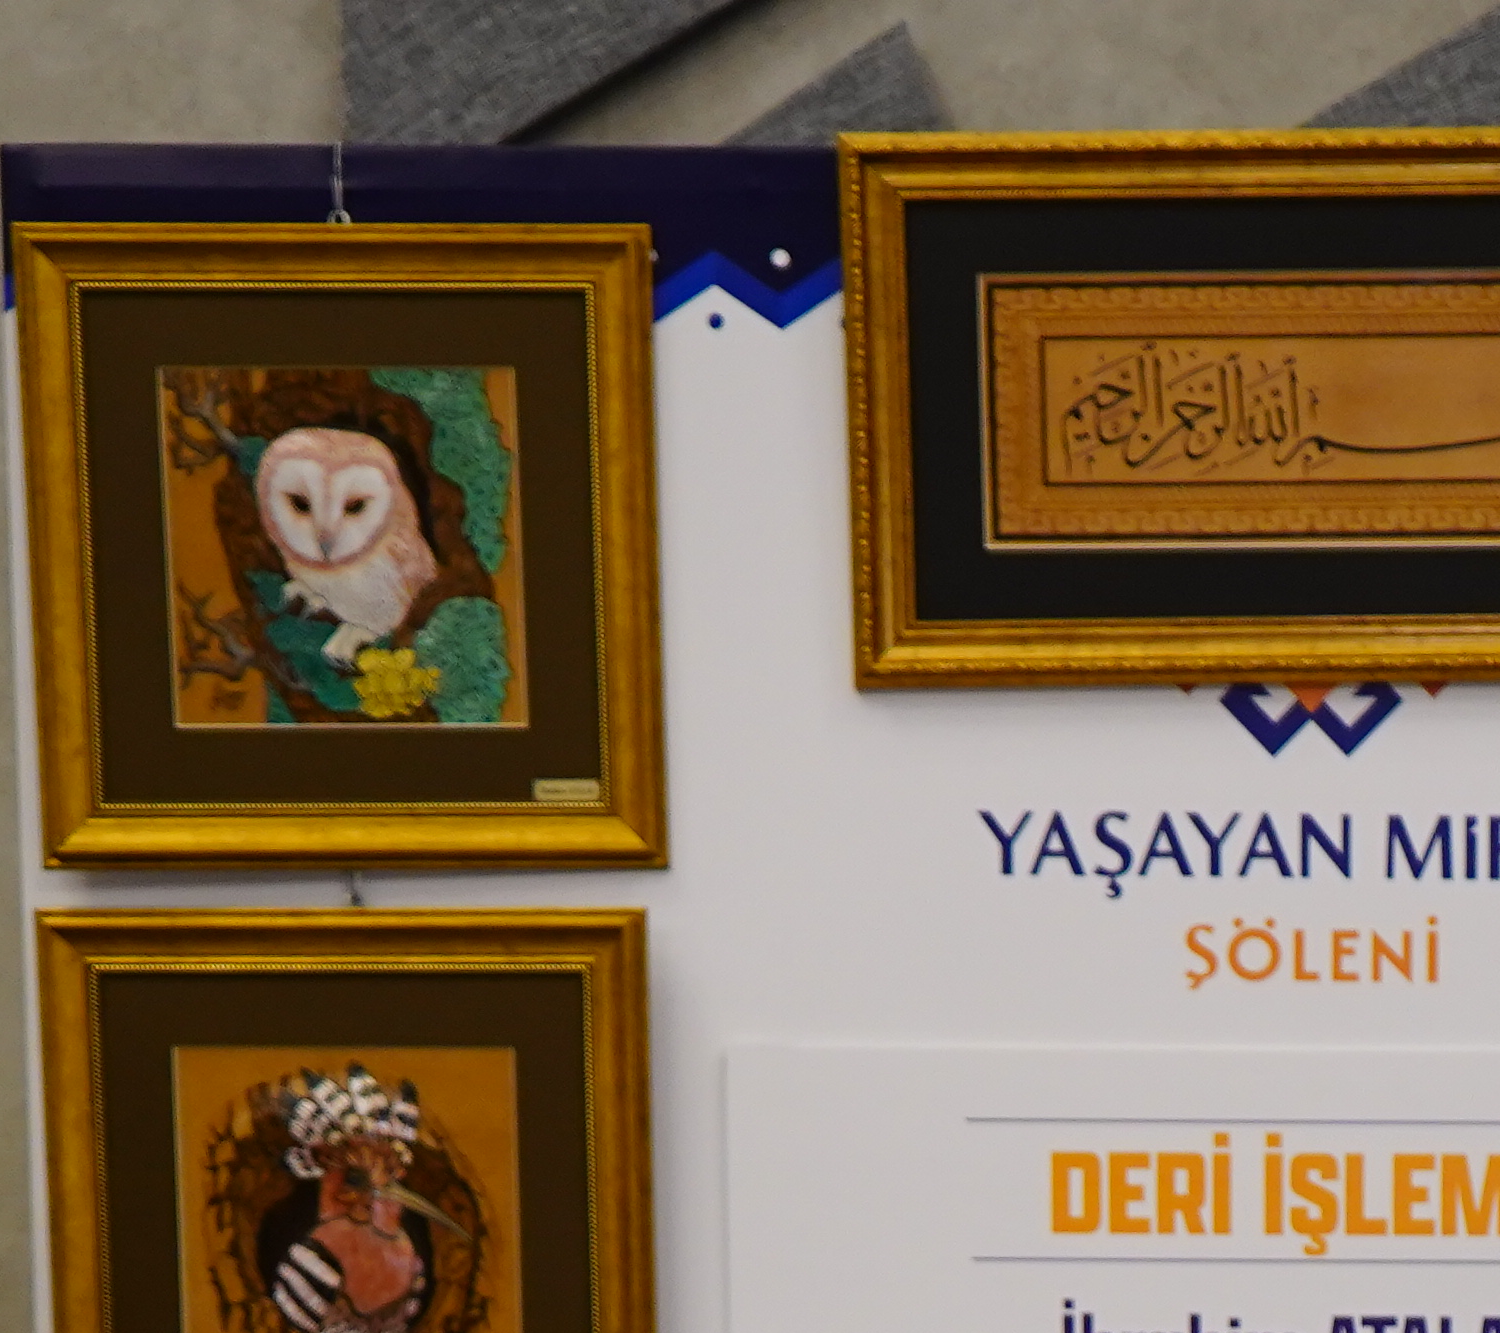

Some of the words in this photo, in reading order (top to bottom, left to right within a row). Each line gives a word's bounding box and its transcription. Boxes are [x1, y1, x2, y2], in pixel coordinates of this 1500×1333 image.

[978, 810, 1353, 900] YAŞAYAN
[1184, 916, 1440, 990] ŞÖLENİ
[1051, 1133, 1233, 1237] DERİ
